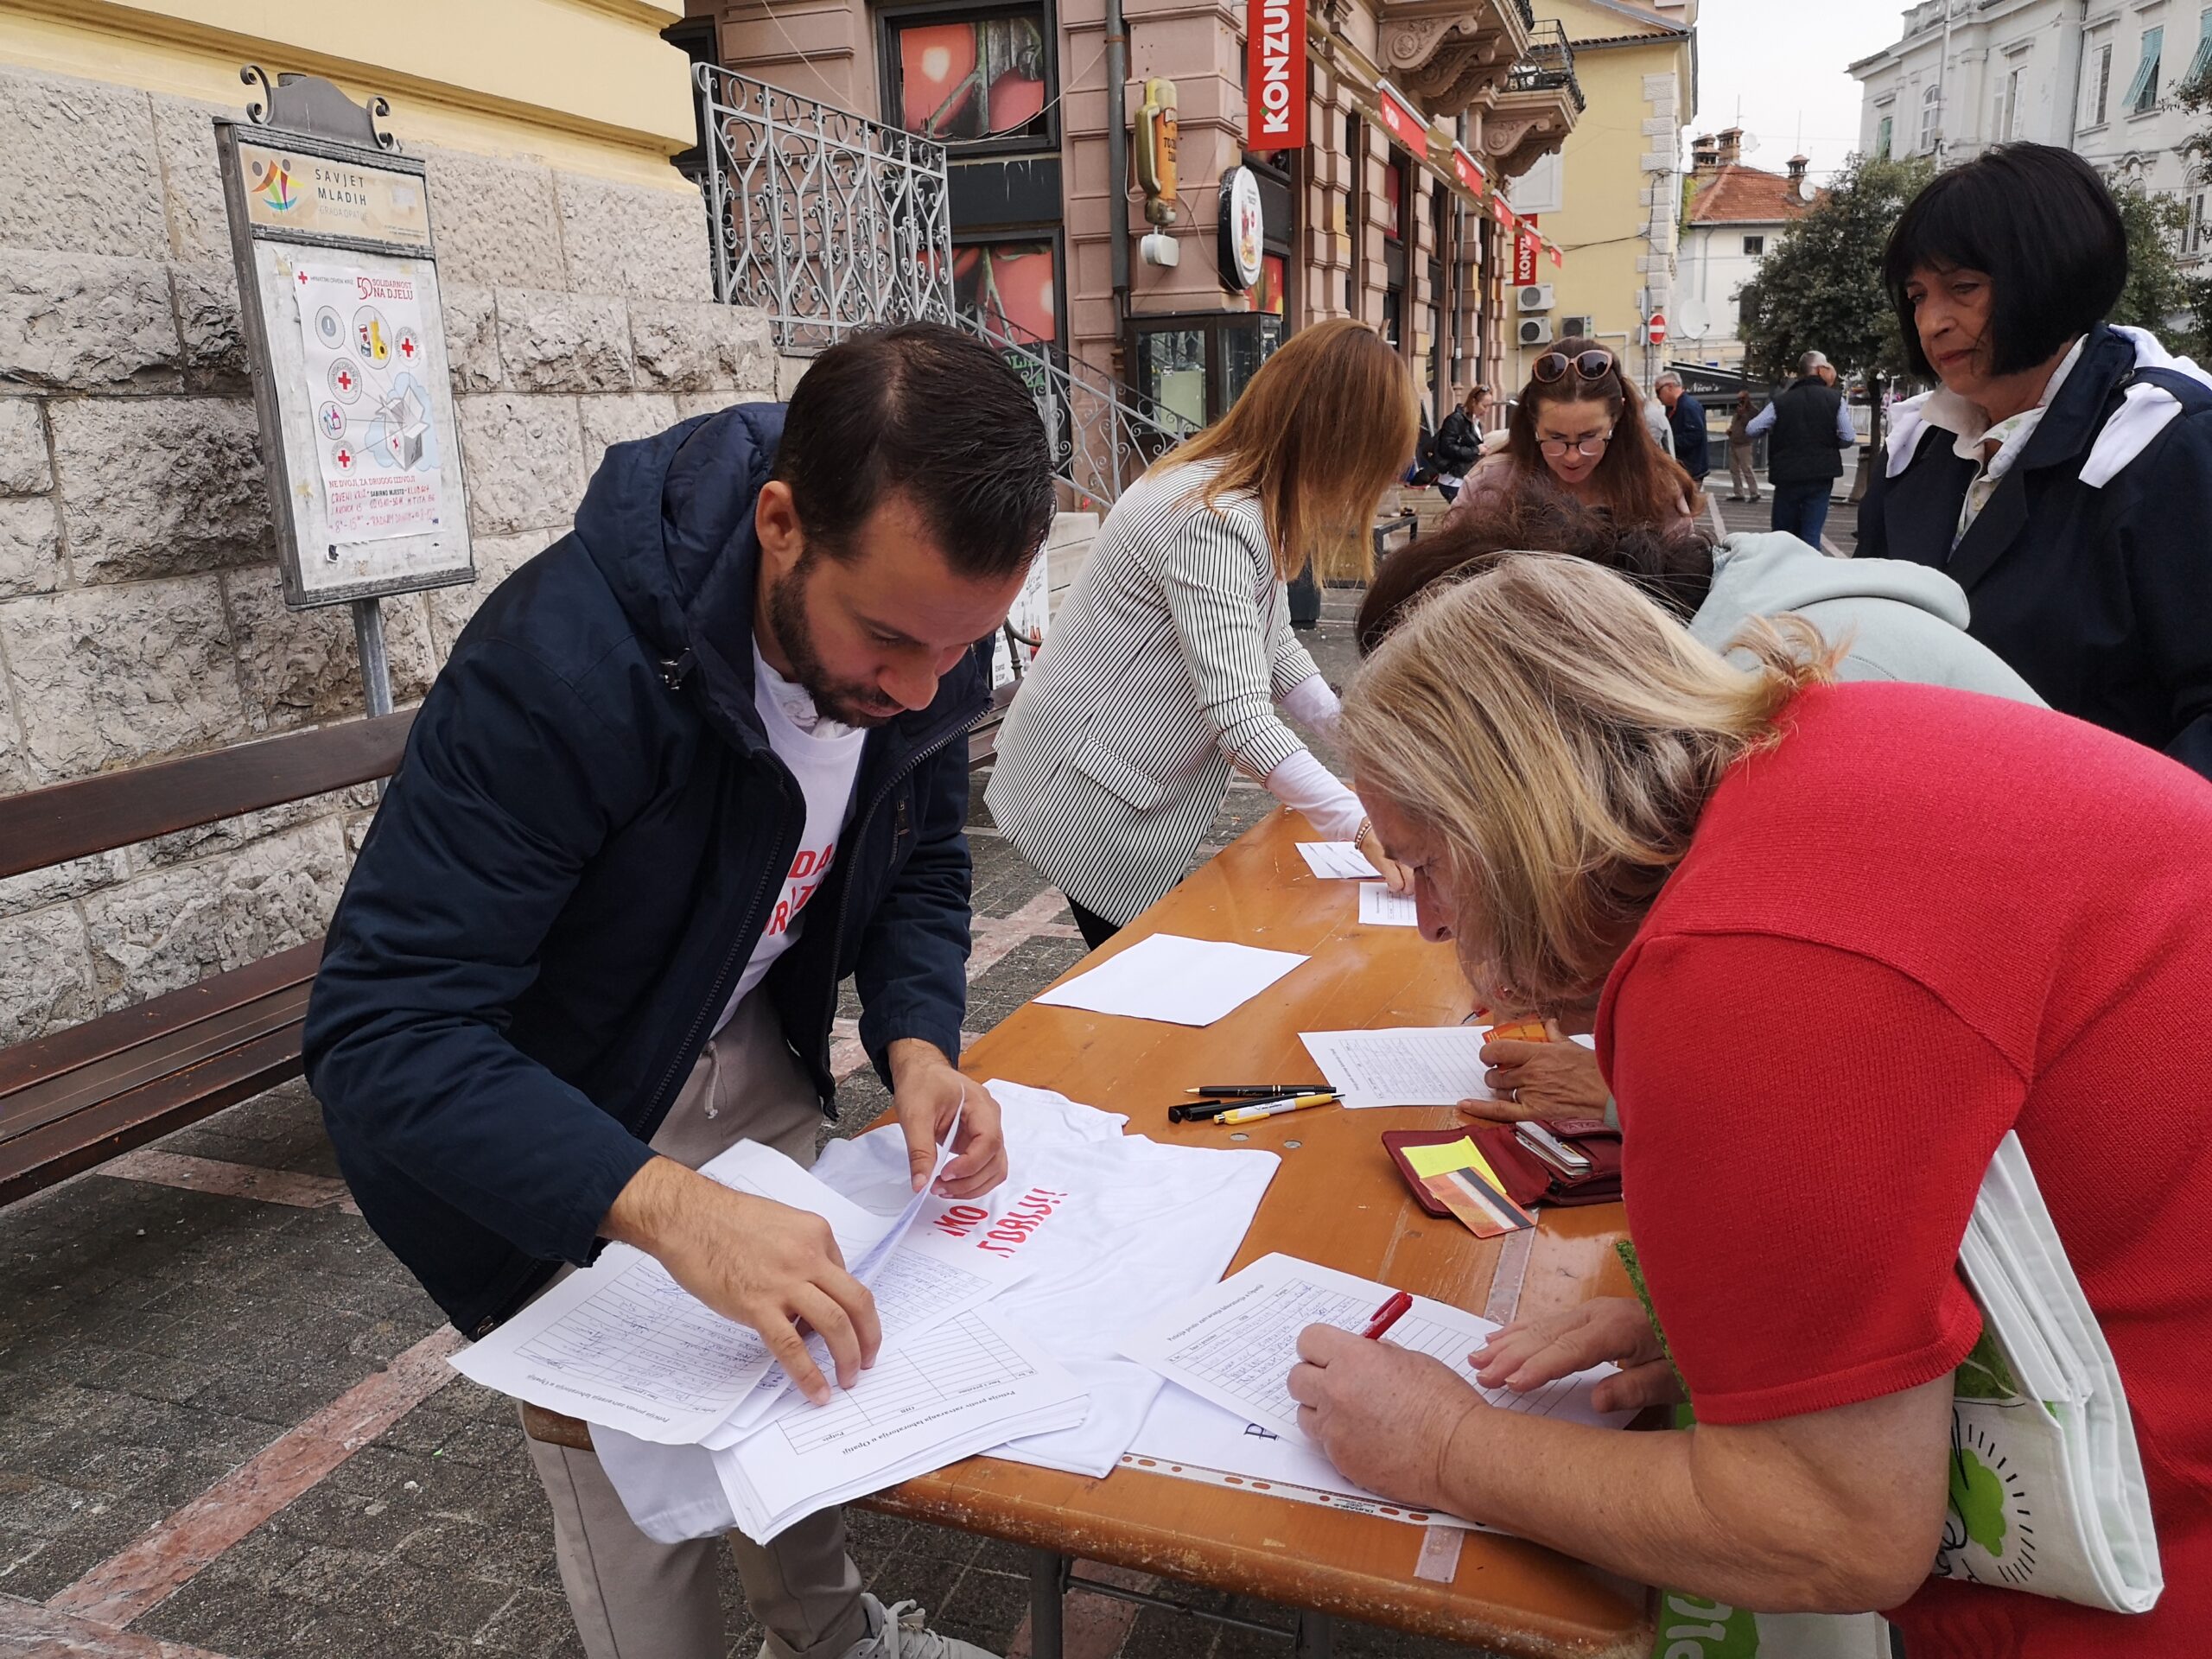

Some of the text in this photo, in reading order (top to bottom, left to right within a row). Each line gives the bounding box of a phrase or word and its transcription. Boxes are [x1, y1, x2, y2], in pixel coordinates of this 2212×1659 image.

[1262, 0, 1290, 133] KONZU
[315, 168, 365, 188] SAVJET
[317, 188, 367, 206] MLADIH
[319, 206, 343, 217] GRADA
[372, 278, 412, 289] SOLIDARNOST
[373, 287, 413, 301] NA DJELU
[988, 1390, 1016, 1402] Peticija
[924, 1406, 963, 1422] zatvaranja
[822, 1431, 845, 1444] Potpis
[878, 1420, 925, 1440] laboratorija
[842, 1440, 871, 1455] Opatiji
